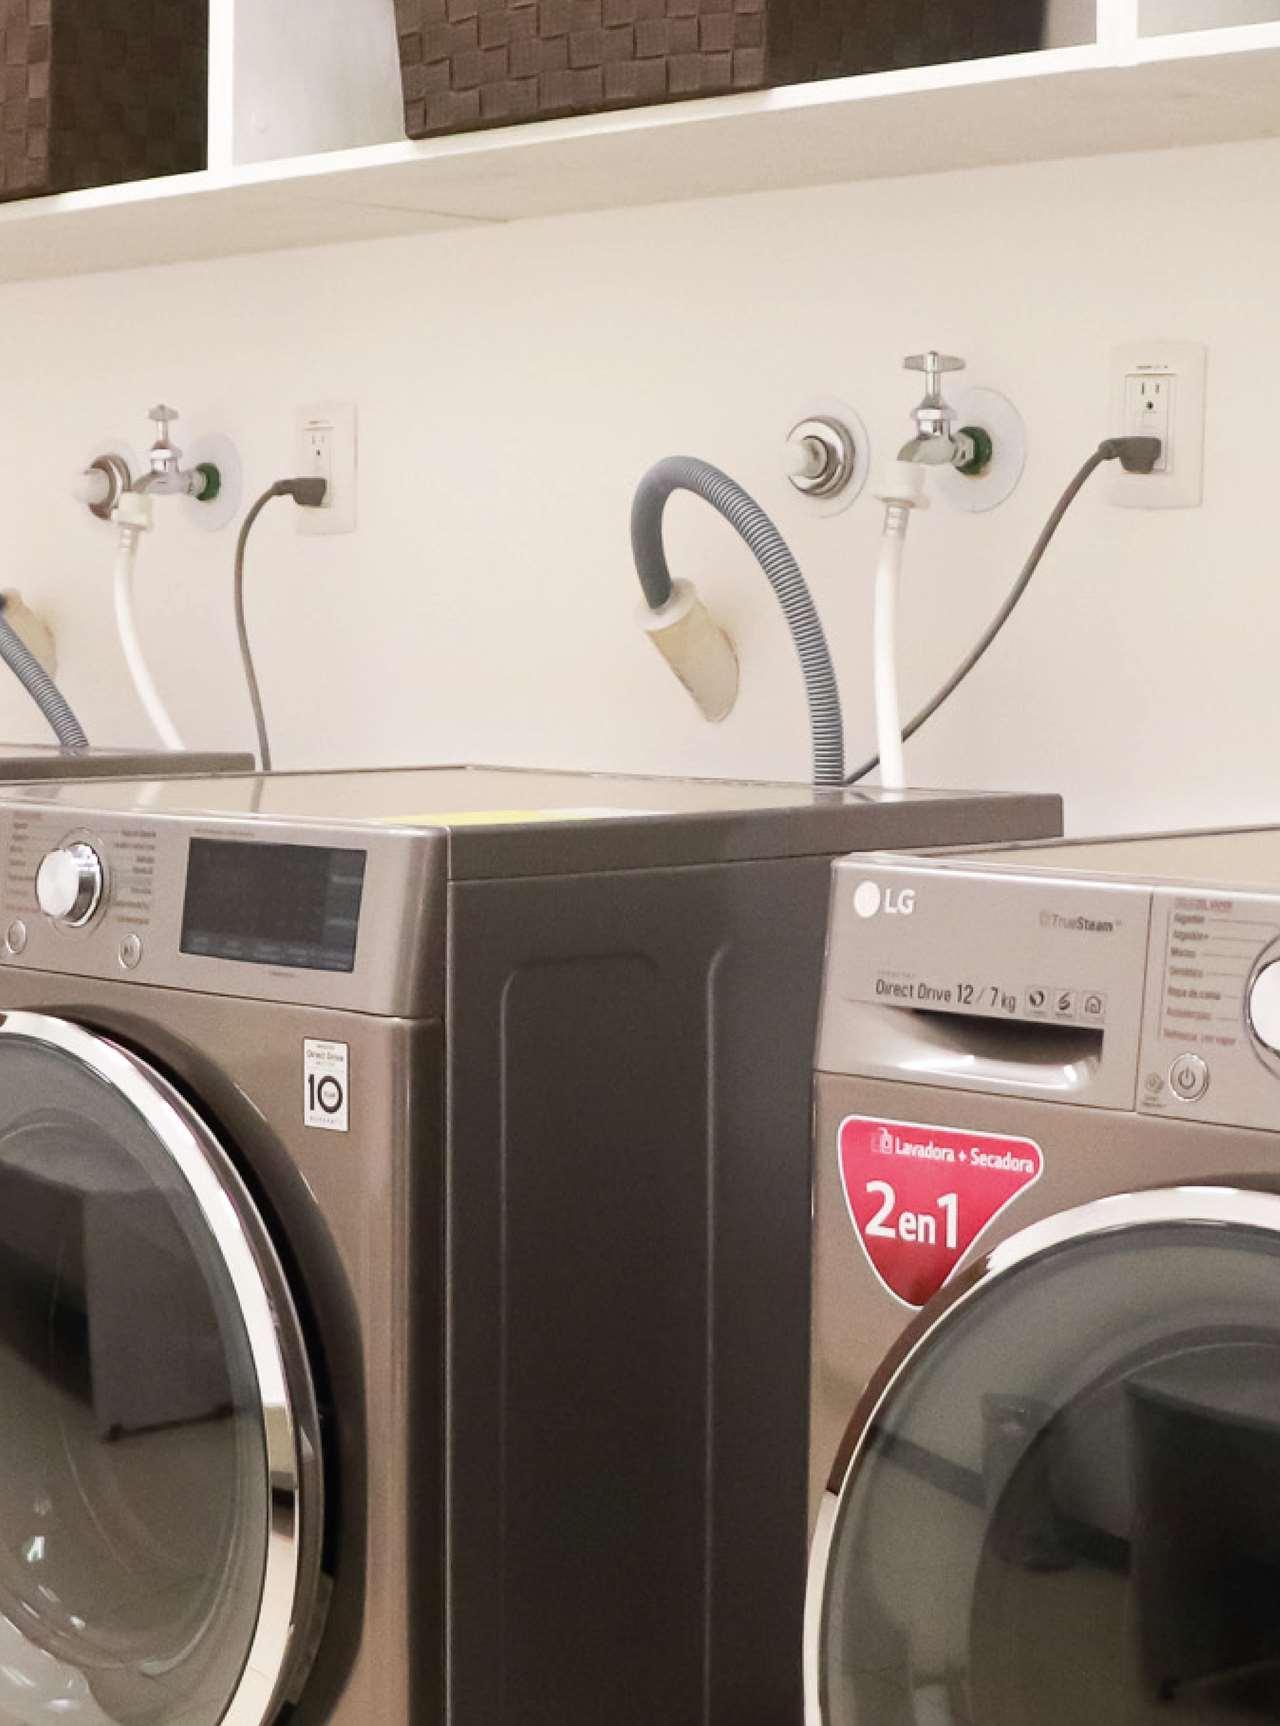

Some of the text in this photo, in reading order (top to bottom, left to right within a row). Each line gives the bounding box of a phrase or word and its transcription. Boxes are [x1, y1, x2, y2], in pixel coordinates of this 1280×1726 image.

[884, 887, 916, 915] LG
[875, 978, 914, 999] Direct
[917, 982, 952, 1001] Drive
[956, 984, 974, 1005] 12
[308, 1073, 343, 1114] 10
[895, 1137, 955, 1162] Lavadora
[970, 1147, 1035, 1174] Secadora
